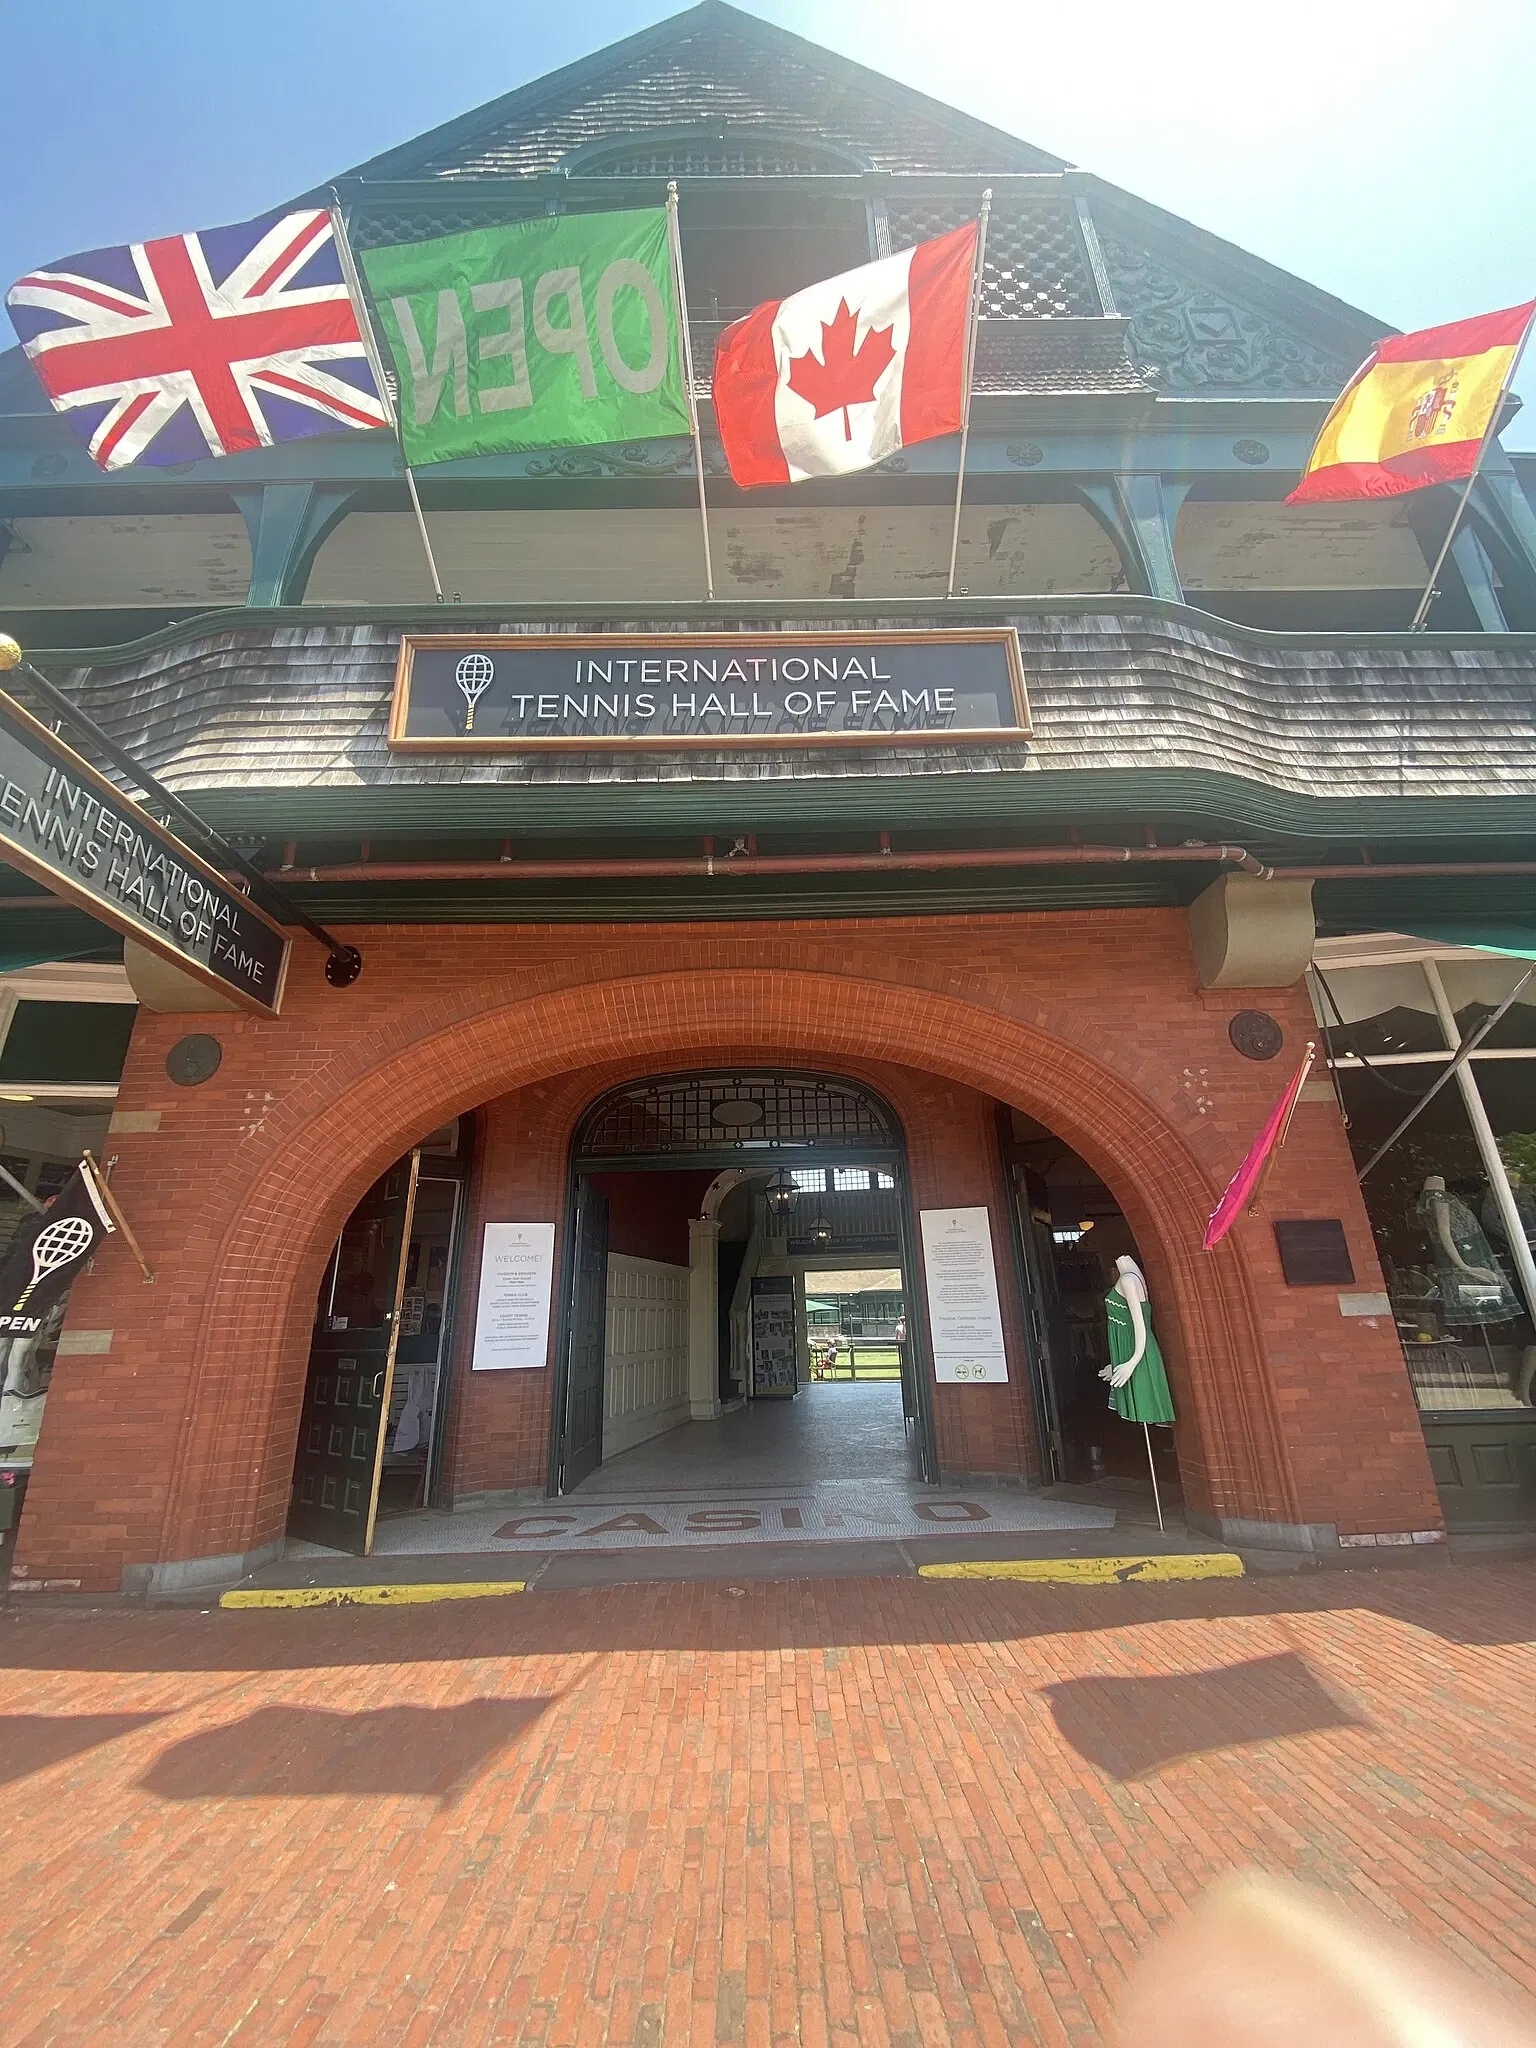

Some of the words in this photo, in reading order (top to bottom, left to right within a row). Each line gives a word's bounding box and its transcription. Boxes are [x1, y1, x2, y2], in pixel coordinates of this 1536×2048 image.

[575, 656, 892, 686] INTERNATIONAL
[511, 692, 657, 719] TENNIS
[672, 690, 774, 718] HALL
[783, 690, 837, 716] OF
[852, 687, 957, 715] FAME
[43, 766, 244, 937] INTERNATIONAL
[0, 772, 103, 870] ENNIS
[107, 858, 173, 925] HALL
[179, 909, 213, 943] OF
[213, 932, 266, 985] FAME
[495, 1254, 542, 1263] WELCOME!
[0, 1315, 42, 1332] PEN
[491, 1500, 992, 1541] CASINO
